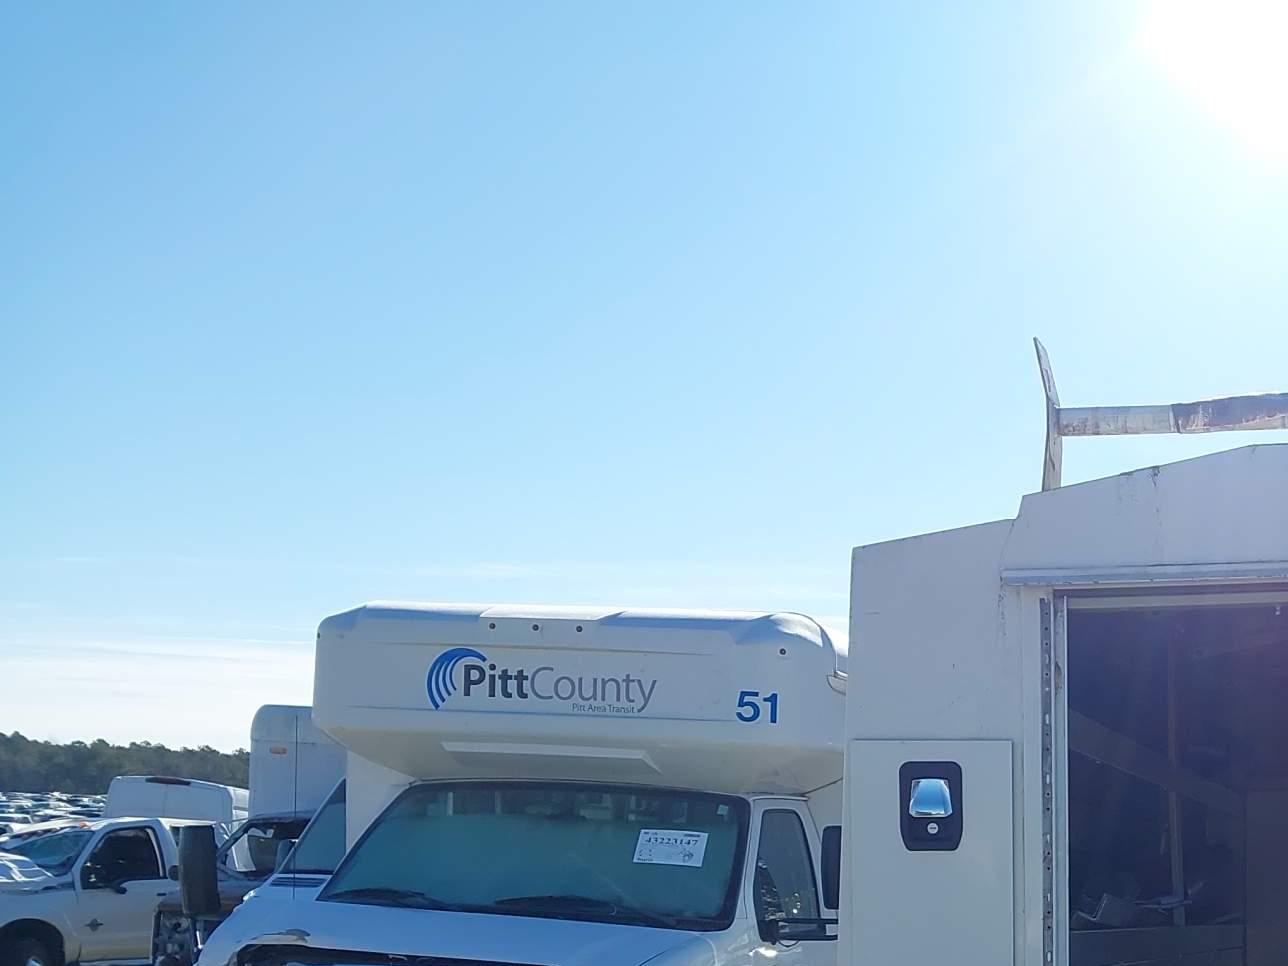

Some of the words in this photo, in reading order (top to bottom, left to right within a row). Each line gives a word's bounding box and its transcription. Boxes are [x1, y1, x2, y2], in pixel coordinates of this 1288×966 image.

[463, 664, 657, 713] PittCounty
[607, 704, 635, 713] Transit
[735, 690, 778, 724] 51
